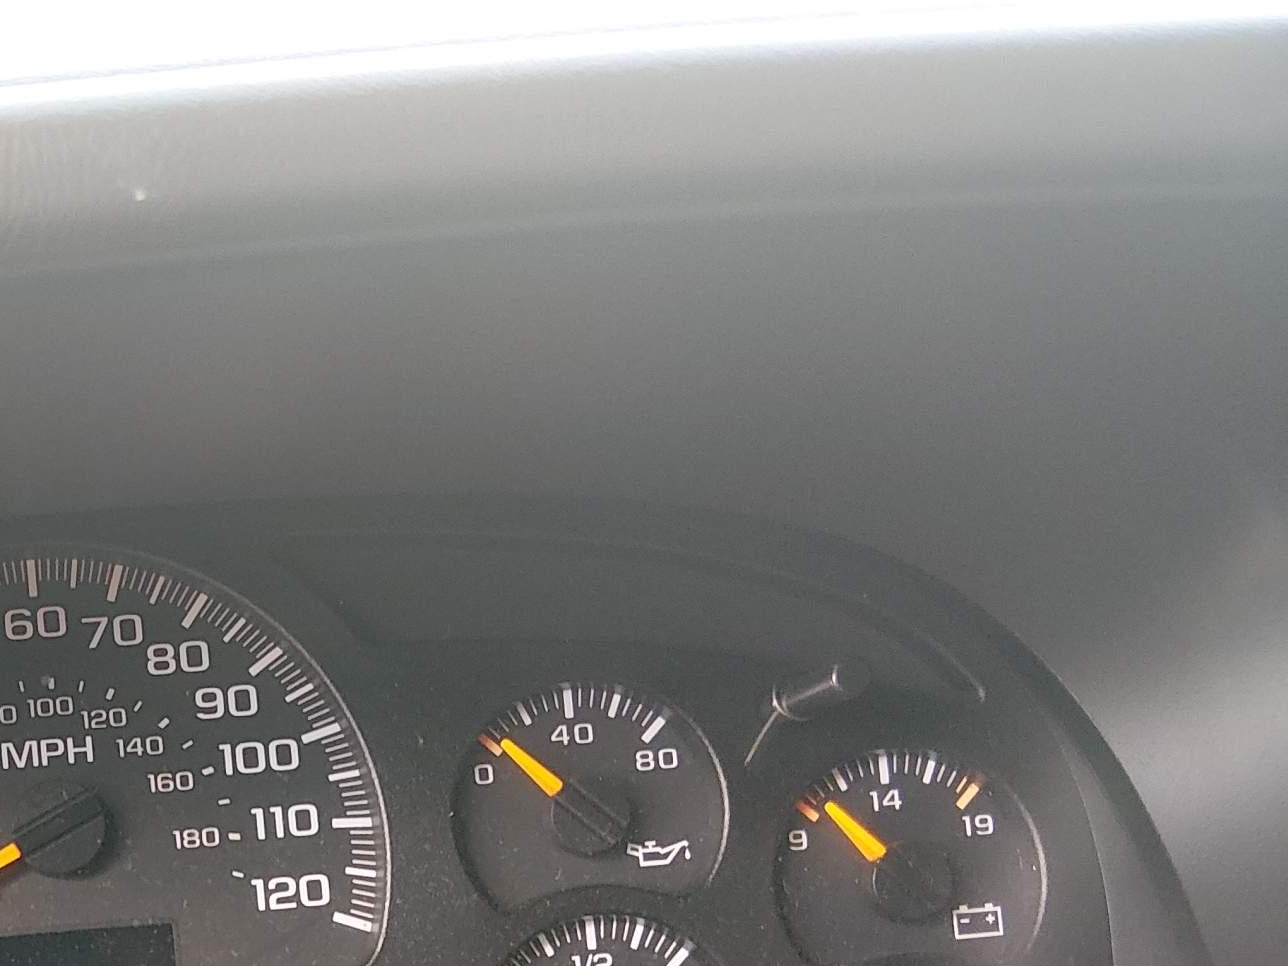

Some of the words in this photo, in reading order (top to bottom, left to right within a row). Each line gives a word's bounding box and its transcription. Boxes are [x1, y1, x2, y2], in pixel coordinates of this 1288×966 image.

[4, 606, 67, 640] 60
[81, 614, 143, 649] 70
[146, 640, 210, 675] 80
[27, 696, 74, 718] 100
[195, 684, 258, 720] 90
[80, 708, 127, 730] 120
[550, 723, 594, 746] 40
[0, 735, 94, 770] MPH
[116, 735, 164, 758] 140
[218, 738, 300, 776] 100
[635, 748, 678, 771] 80
[147, 771, 194, 793] 160
[474, 764, 494, 785] 0
[869, 789, 902, 812] 14
[250, 804, 319, 840] 110
[961, 814, 994, 837] 19
[172, 827, 220, 850] 180
[789, 830, 808, 851] 9
[250, 873, 330, 911] 120
